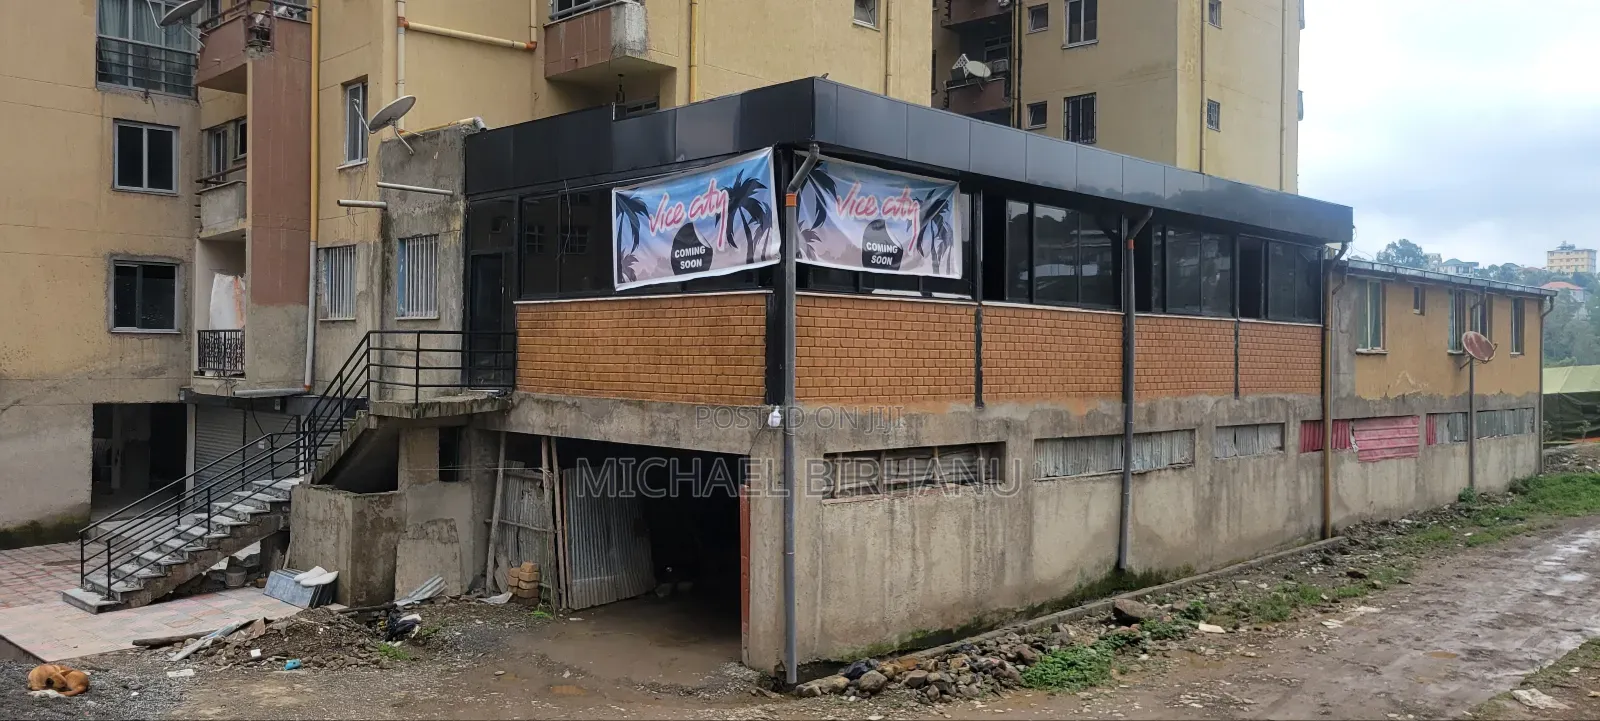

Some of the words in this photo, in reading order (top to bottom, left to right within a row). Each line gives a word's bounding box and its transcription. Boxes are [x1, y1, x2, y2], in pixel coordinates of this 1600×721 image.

[650, 192, 686, 236] Vice
[689, 180, 729, 249] city
[836, 180, 877, 220] Vice
[881, 184, 919, 252] city
[674, 246, 706, 259] COMING
[866, 241, 898, 254] COMING
[680, 259, 702, 270] SOON
[871, 255, 893, 266] SOON
